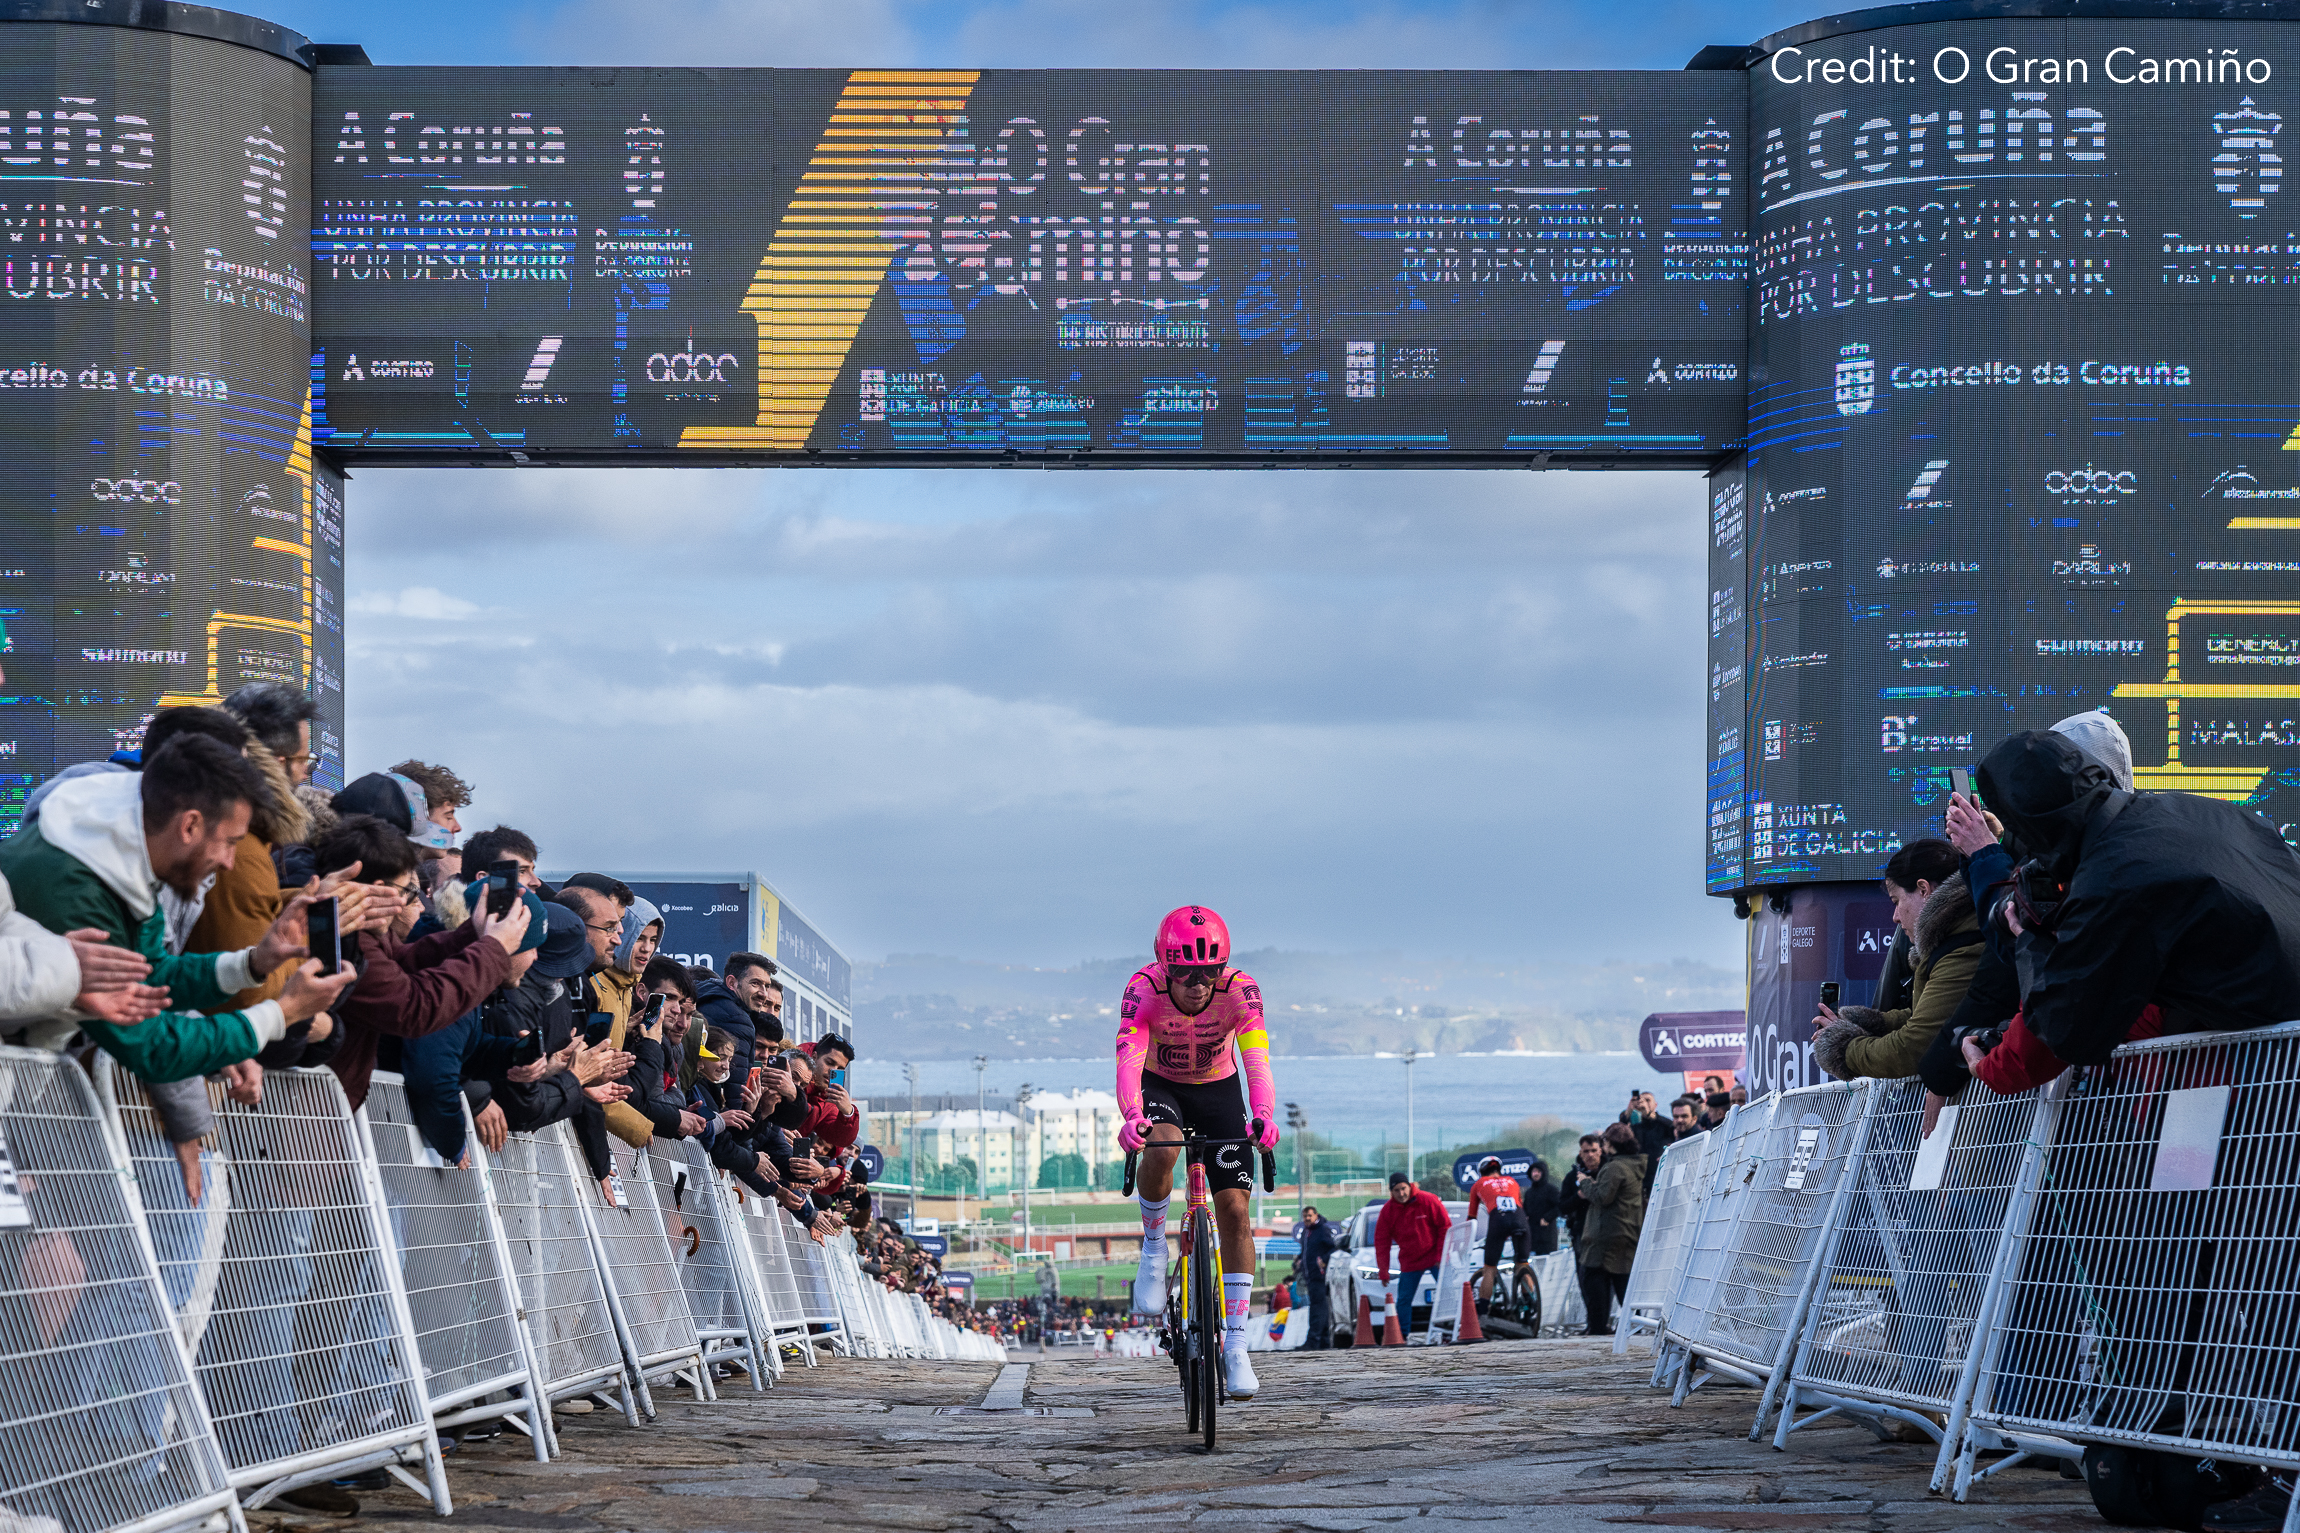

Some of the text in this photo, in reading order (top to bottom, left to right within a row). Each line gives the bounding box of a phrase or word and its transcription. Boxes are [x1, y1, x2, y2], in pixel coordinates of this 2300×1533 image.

[334, 112, 565, 163] A Coruña
[1404, 115, 1631, 167] A Coruña
[1760, 92, 2107, 198] A Coruña
[998, 117, 1209, 195] O Gran
[1891, 360, 2191, 389] Concello da Coruña
[1778, 803, 1847, 828] XUNTA
[1778, 829, 1902, 856] DE GALICIA
[703, 903, 739, 916] galicia
[1792, 926, 1816, 936] DEPORTE
[1792, 938, 1814, 948] GALEGO
[1165, 949, 1181, 962] EF
[1751, 1024, 1762, 1091] O
[1225, 1299, 1250, 1316] EF
